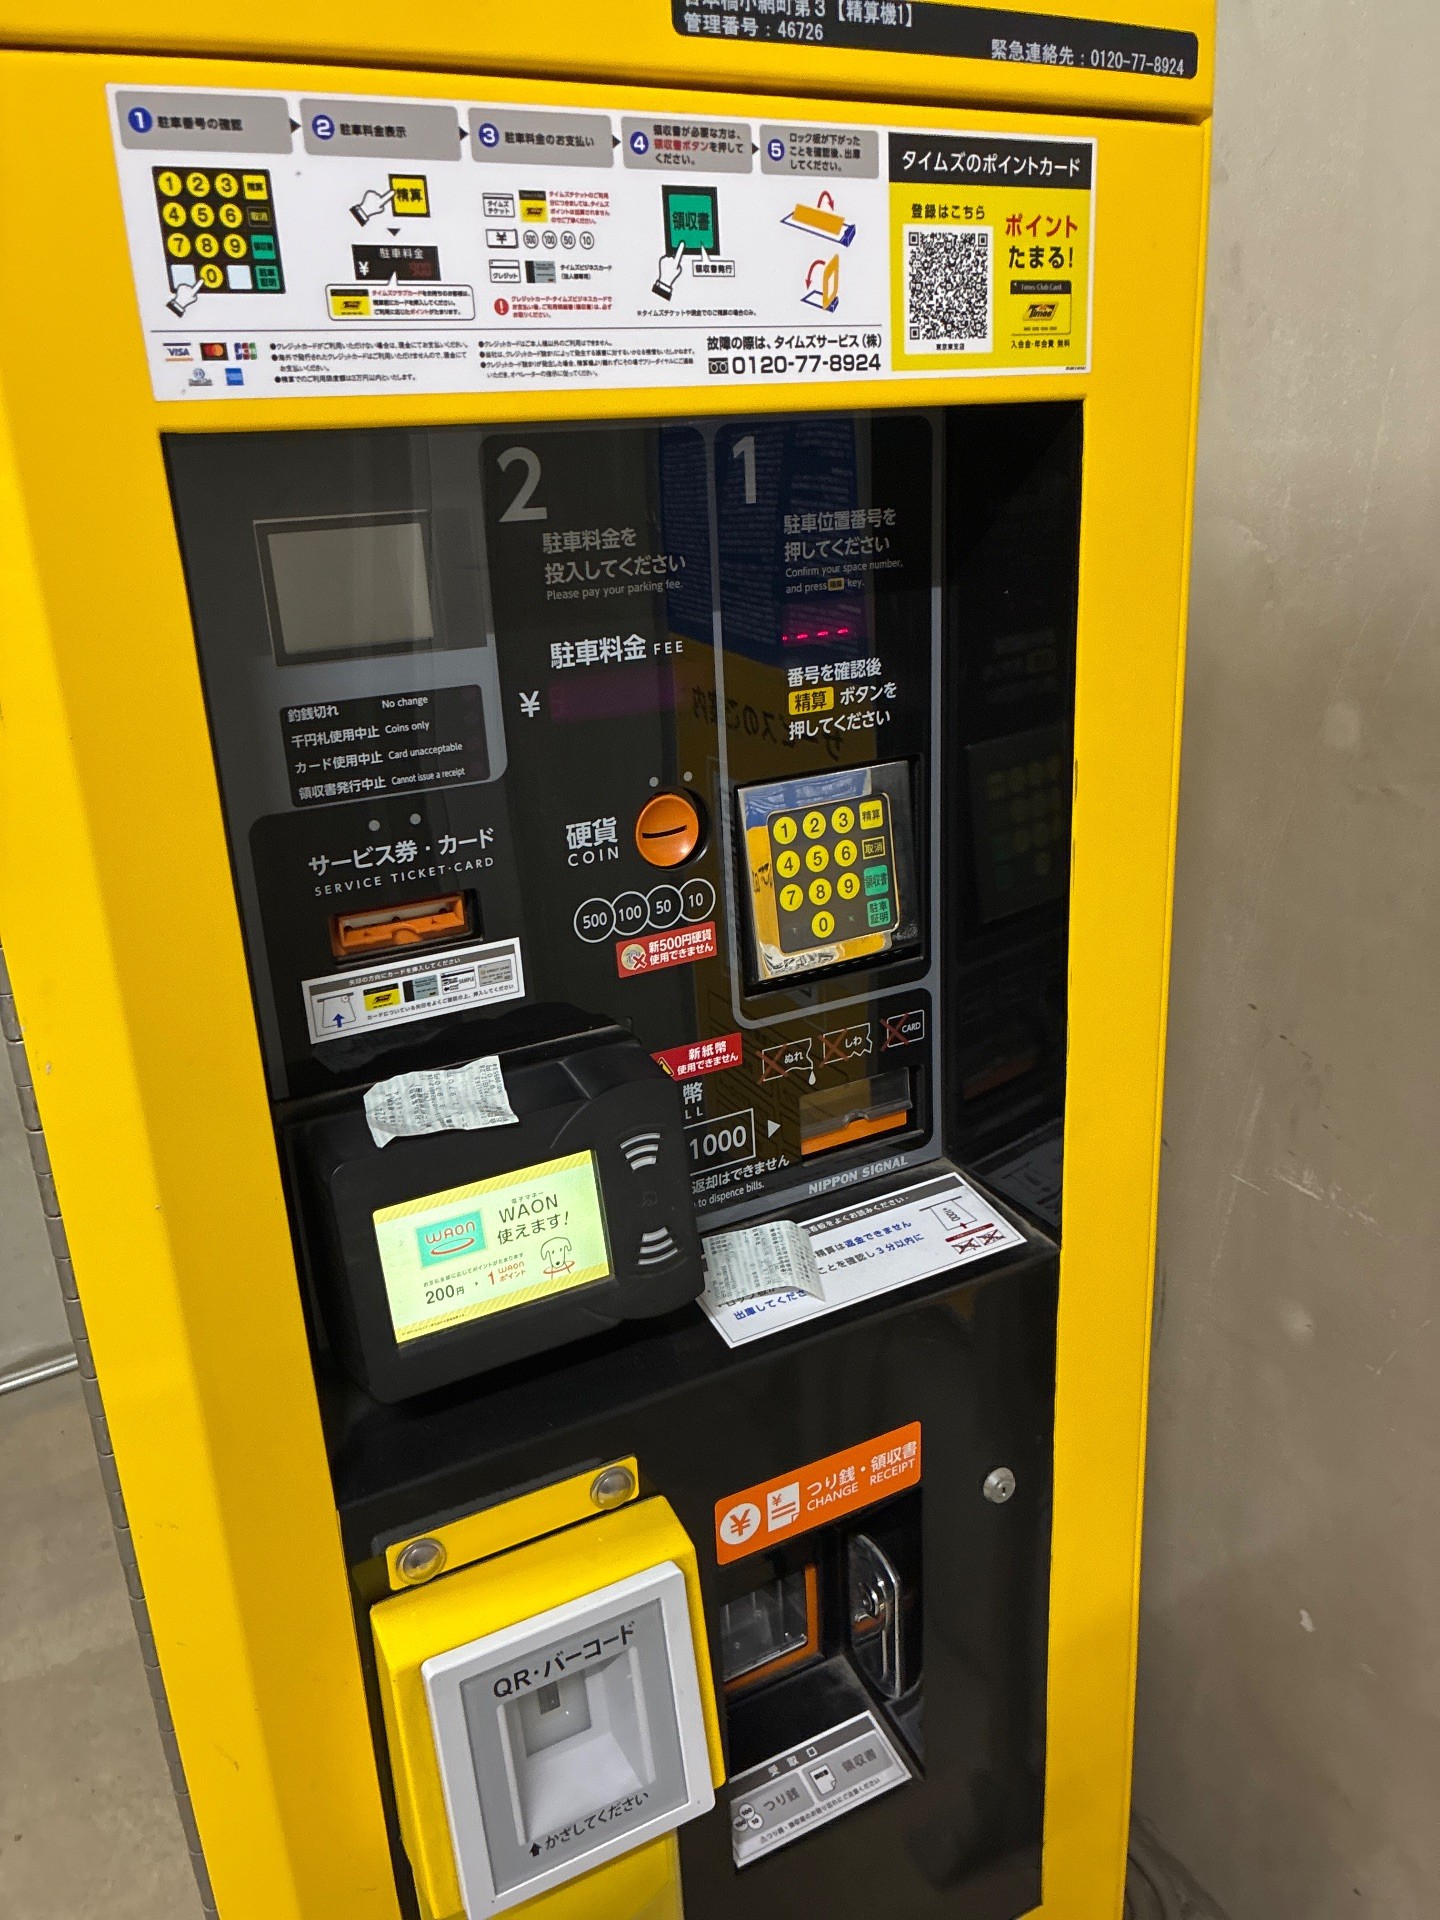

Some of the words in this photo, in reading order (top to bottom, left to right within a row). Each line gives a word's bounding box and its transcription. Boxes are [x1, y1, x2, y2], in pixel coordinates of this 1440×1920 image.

[134, 112, 144, 128] 1
[157, 116, 243, 131] 駐車番号の確認
[317, 119, 329, 134] 2
[340, 123, 407, 138] 駐車料金表示
[484, 128, 494, 143] 3
[504, 131, 594, 147] 駐車料金のお支払い
[634, 135, 646, 151] 4
[771, 143, 781, 157] 5
[655, 153, 696, 166] ください。
[790, 160, 842, 172] してください。
[902, 150, 1080, 177] タイムズのポイントカード
[166, 176, 173, 190] 1
[192, 177, 203, 191] 2
[221, 177, 232, 193] 3
[396, 187, 422, 203] 精算
[169, 207, 179, 221] 4
[198, 208, 208, 222] 5
[225, 208, 236, 222] 6
[672, 209, 710, 231] 領収書
[911, 203, 986, 220] 登録はこちら
[1005, 213, 1078, 238] ポイント
[173, 238, 184, 252] 7
[202, 238, 212, 252] 8
[230, 238, 240, 253] 9
[380, 247, 424, 260] 駐車料金
[564, 236, 573, 245] 50
[583, 236, 591, 245] 10
[206, 268, 217, 283] 0
[695, 262, 733, 276] 領収書発行
[167, 347, 190, 356] VISA
[732, 354, 881, 375] 0120-77-8924
[732, 435, 757, 504] 1
[497, 446, 548, 523] 2
[783, 507, 897, 535] 駐車位置番号を
[542, 527, 637, 555] 駐車料金を
[784, 536, 890, 562] 押してください
[544, 553, 686, 585] 投入してください
[785, 566, 820, 578] Confirm
[821, 565, 841, 576] your
[843, 562, 868, 574] space
[869, 559, 903, 570] number.
[547, 589, 580, 601] Please
[582, 587, 600, 600] pay
[603, 584, 624, 597] your
[627, 580, 663, 595] parking
[665, 579, 684, 590] fee.
[786, 583, 802, 594] and
[804, 582, 828, 594] press
[847, 579, 865, 588] key.
[550, 633, 647, 670] 駐車料金
[653, 640, 684, 656] FEE
[787, 658, 882, 687] 番号を確認後
[287, 704, 339, 723] 釣銭切れ
[382, 700, 395, 709] No
[397, 696, 429, 709] change
[518, 690, 541, 718] ¥
[795, 691, 827, 711] 精算
[840, 682, 897, 705] ボタンを
[291, 726, 380, 749] 千円札使用中止
[385, 724, 409, 734] Coins
[411, 721, 430, 732] only
[788, 711, 891, 741] 押してください
[295, 751, 383, 774] カード使用中止
[388, 749, 408, 760] Card
[410, 742, 463, 758] unacceptable
[298, 776, 386, 800] 領収書発行中止
[391, 775, 416, 786] Cannot
[418, 772, 435, 782] issue
[442, 768, 465, 779] receipt
[565, 816, 619, 850] 硬貨
[781, 824, 789, 838] 1
[810, 817, 820, 833] 2
[838, 812, 848, 828] 3
[862, 809, 880, 821] 精算
[308, 827, 494, 877] サービス券・カード
[567, 846, 619, 867] COIN
[784, 857, 793, 872] 4
[813, 851, 822, 867] 5
[841, 845, 851, 860] 6
[864, 842, 883, 855] 取消
[315, 875, 382, 896] SERVICE
[786, 890, 796, 906] 7
[816, 884, 825, 900] 8
[844, 878, 853, 893] 9
[864, 872, 888, 888] 領収書
[582, 911, 608, 930] 500
[618, 905, 642, 922] 100
[656, 899, 672, 915] 50
[688, 892, 704, 908] 10
[819, 917, 828, 932] 0
[869, 901, 889, 913] 駐車
[870, 911, 889, 925] 証明
[648, 928, 712, 954] 新500円硬貨
[650, 943, 714, 966] 使用できません
[349, 957, 461, 986] 矢印の方向にカードを挿入してください
[688, 1039, 727, 1060] 新紙幣
[784, 1050, 804, 1065] ぬれ
[844, 1036, 862, 1049] しわ
[902, 1021, 921, 1033] CARD
[677, 1052, 739, 1075] 使用できません
[689, 1125, 747, 1160] 1000
[809, 1170, 858, 1195] NIPPON
[862, 1156, 908, 1179] SIGNAL
[698, 1197, 708, 1208] to
[709, 1188, 744, 1205] dispence
[746, 1181, 765, 1195] bills.
[499, 1194, 559, 1224] WAON
[806, 1196, 909, 1233] 看板をよくお読みください。
[814, 1221, 912, 1258] 精算は返金できません
[425, 1285, 465, 1305] 200円
[487, 1271, 495, 1285] 1
[499, 1270, 526, 1282] ポイント
[734, 1289, 807, 1320] 出庫してくださ
[806, 1440, 917, 1497] つり銭・領収書
[806, 1483, 859, 1512] CHANGE
[869, 1459, 915, 1486] RECEIPT
[493, 1620, 636, 1699] QR・バーコード
[545, 1791, 649, 1851] かざしてください
